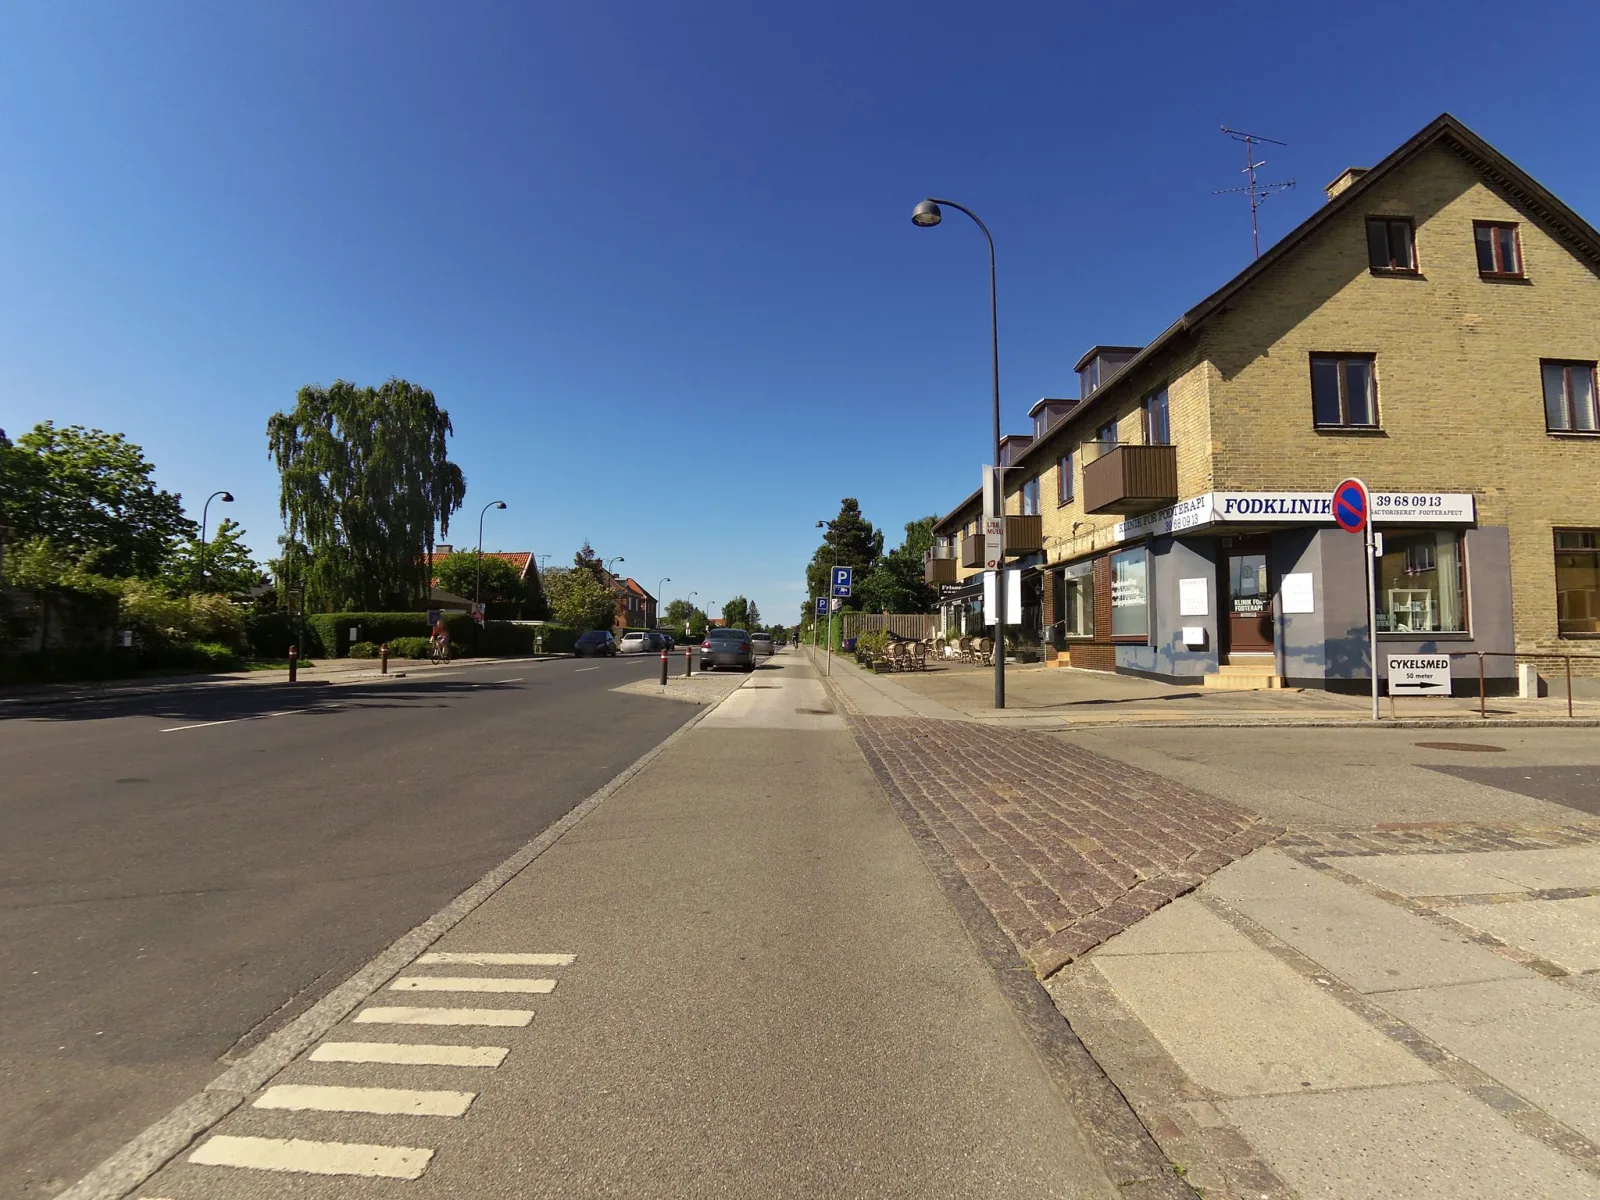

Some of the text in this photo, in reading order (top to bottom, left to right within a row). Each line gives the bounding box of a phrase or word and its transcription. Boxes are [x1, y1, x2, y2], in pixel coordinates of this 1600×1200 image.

[1224, 498, 1332, 514] FODKLINIK
[1376, 495, 1442, 507] 39 68 09 13
[1143, 513, 1157, 526] FOR
[1165, 513, 1198, 531] 39 68 09 13
[837, 570, 848, 584] P
[819, 599, 826, 608] P
[1390, 659, 1449, 669] CYKELSMED
